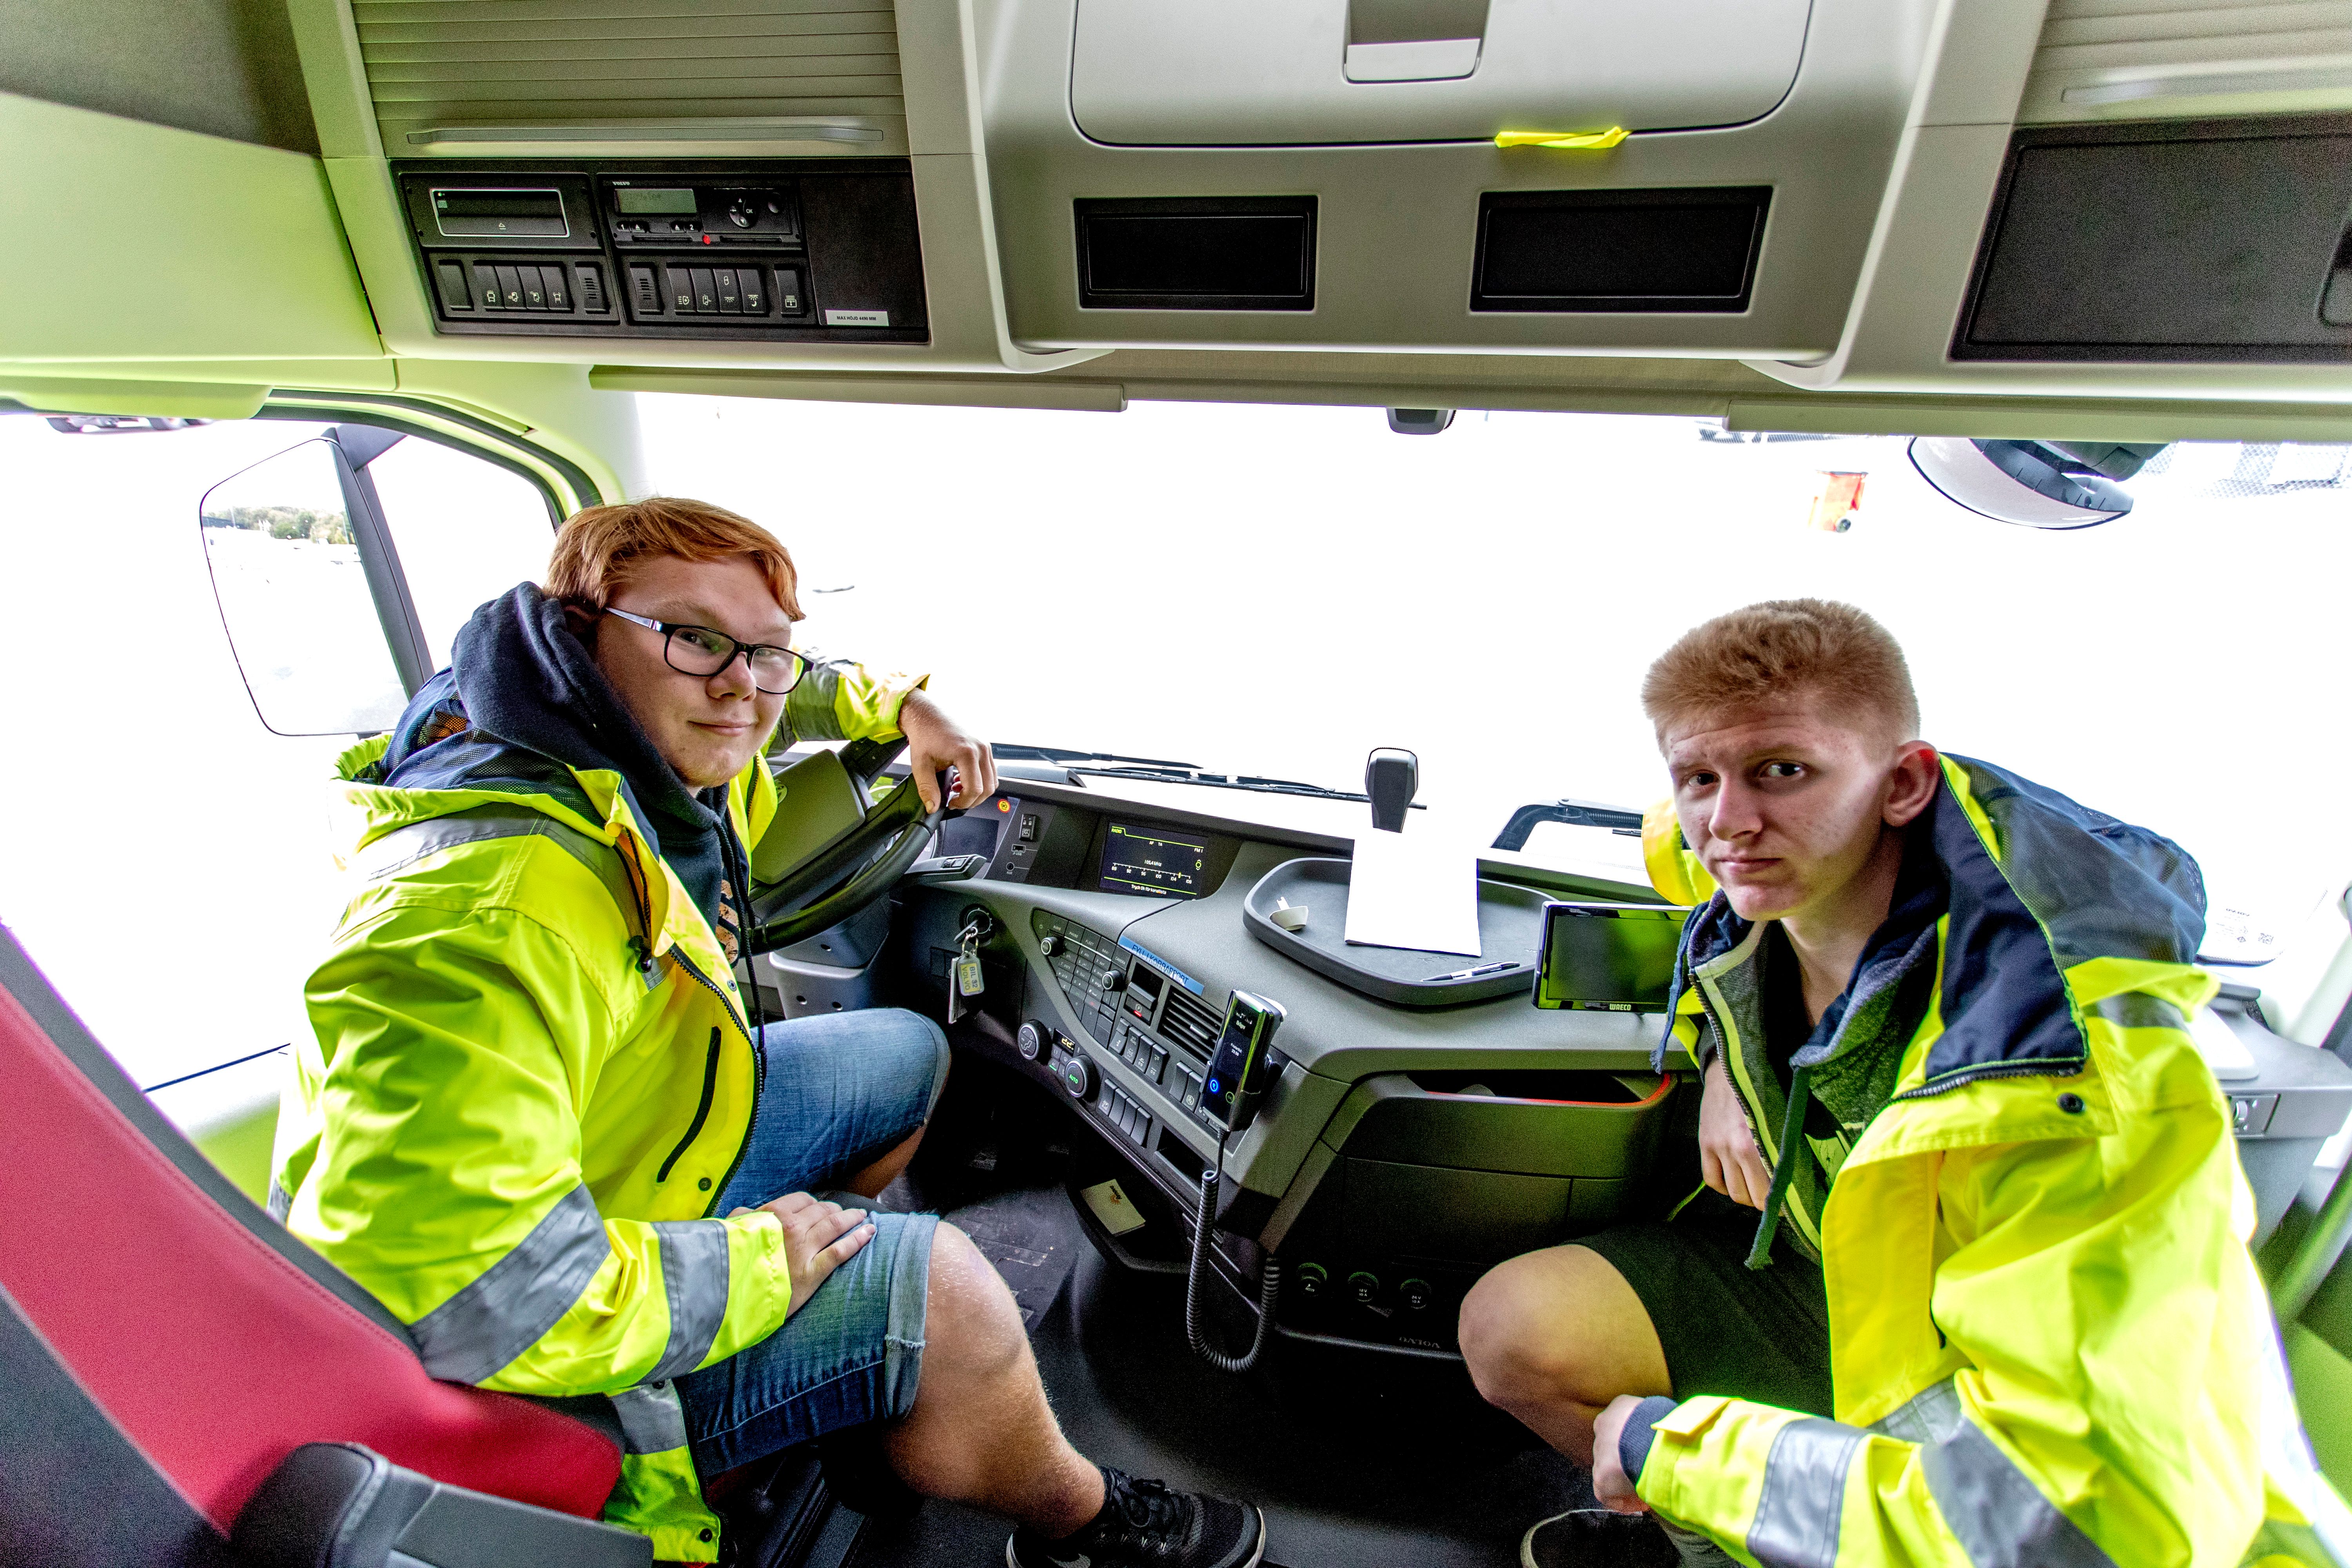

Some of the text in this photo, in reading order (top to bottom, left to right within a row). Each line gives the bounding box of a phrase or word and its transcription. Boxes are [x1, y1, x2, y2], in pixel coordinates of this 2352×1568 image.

[1114, 956, 1126, 965] CAMERA
[962, 966, 970, 990] VOLVO
[971, 980, 978, 988] 32
[1069, 1074, 1078, 1084] AUTO
